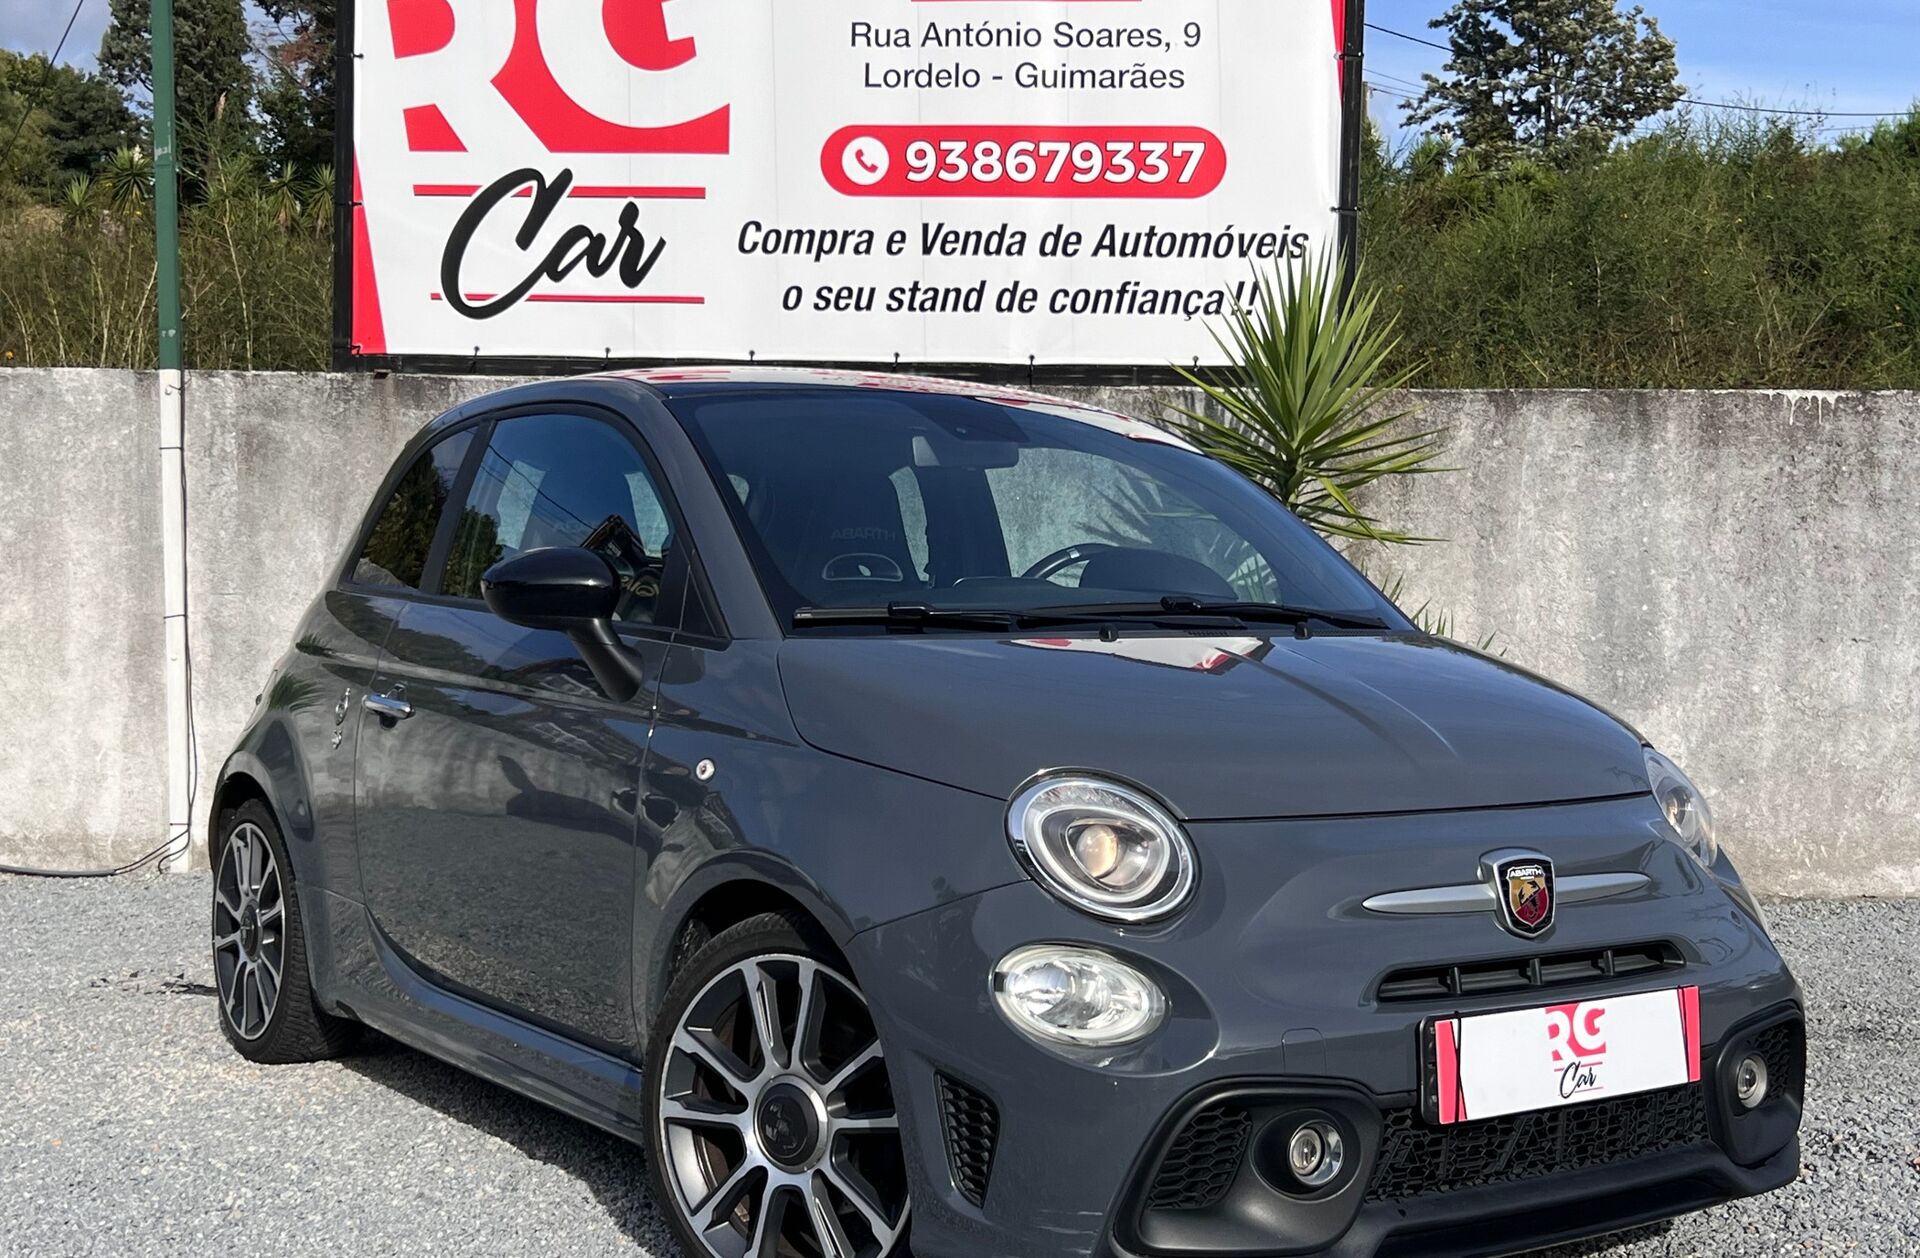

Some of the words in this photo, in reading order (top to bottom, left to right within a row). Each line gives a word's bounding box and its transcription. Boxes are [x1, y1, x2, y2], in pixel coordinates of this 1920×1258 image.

[851, 22, 911, 48] Rua
[920, 20, 1042, 48] António
[1053, 21, 1171, 53] Soares,
[1183, 22, 1201, 48] 9
[864, 62, 981, 88] Lordelo
[1015, 62, 1185, 89] Guimarães
[905, 140, 1206, 184] 938679337
[440, 168, 667, 320] Car
[738, 220, 875, 263] Compra
[886, 230, 907, 256] e
[922, 222, 1027, 257] Venda
[1039, 223, 1082, 258] de
[1091, 224, 1310, 259] Automóveis
[782, 285, 803, 311] o
[813, 285, 876, 312] seu
[886, 279, 987, 313] stand
[995, 280, 1038, 314] de
[831, 527, 896, 541] ABARTH
[1509, 868, 1542, 877] ABARTH
[1545, 1003, 1606, 1061] RG
[1560, 1061, 1597, 1099] Car
